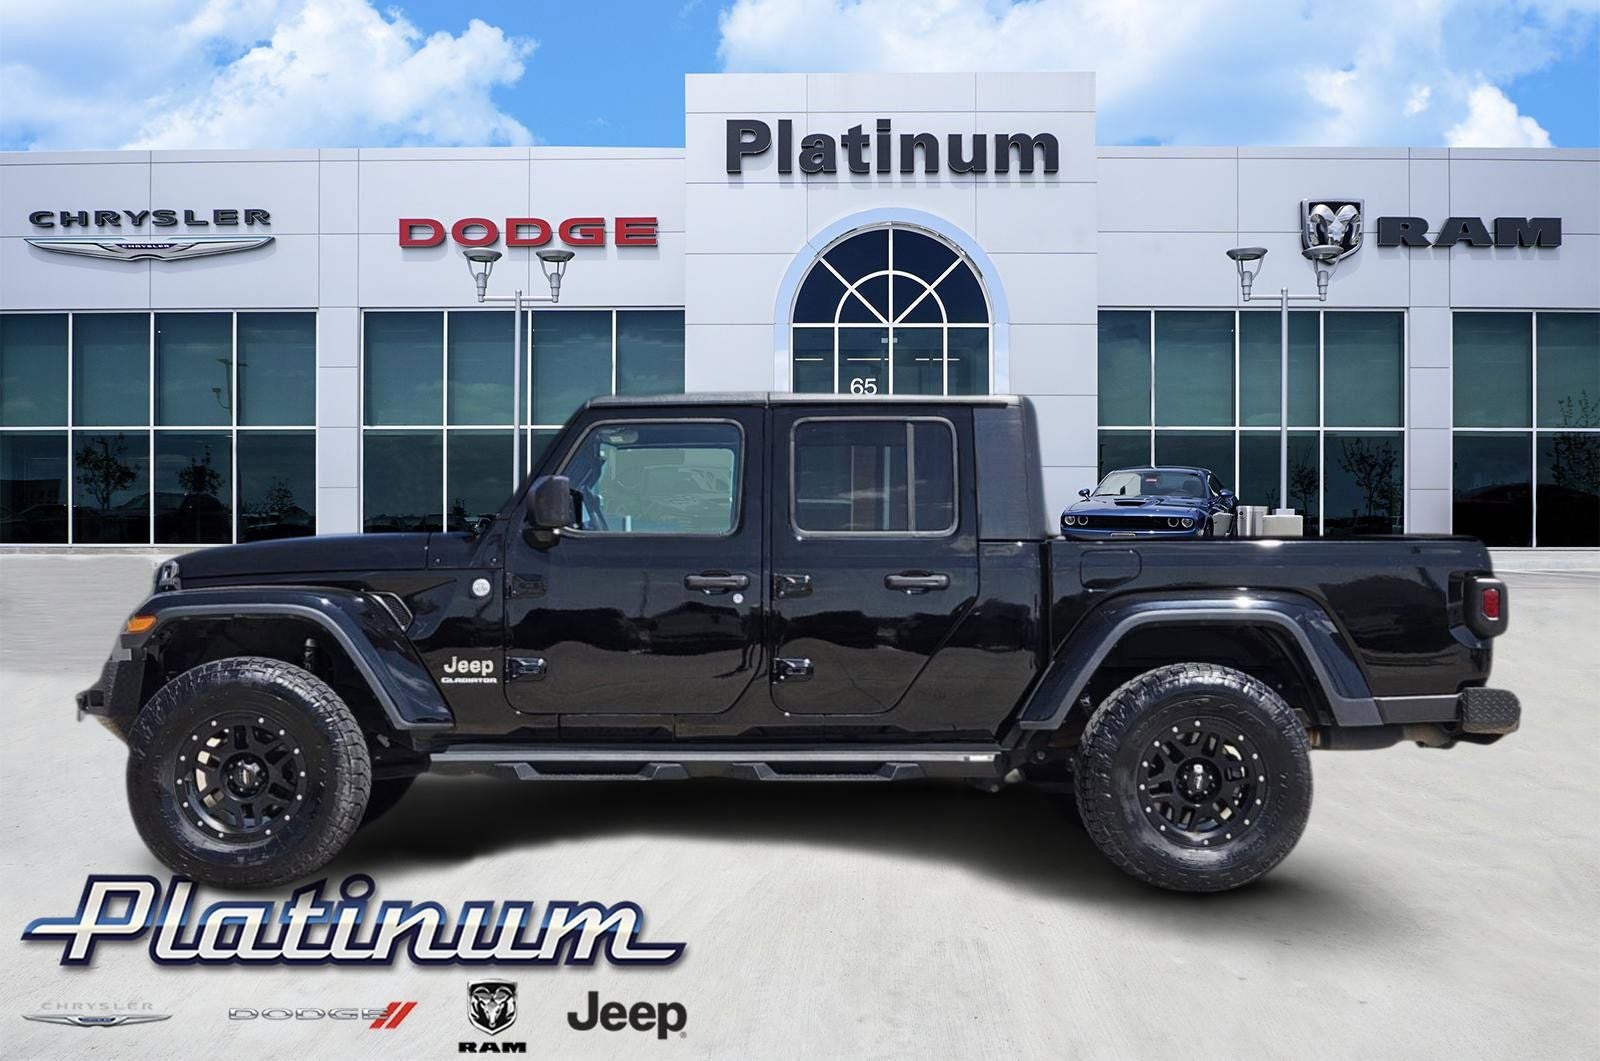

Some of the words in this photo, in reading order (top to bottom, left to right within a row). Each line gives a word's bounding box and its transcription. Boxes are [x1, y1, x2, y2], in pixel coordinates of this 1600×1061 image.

[726, 118, 1060, 176] Platinum
[28, 208, 272, 228] CHRYSLER
[398, 216, 659, 248] DODGE
[1376, 216, 1562, 248] RAM
[850, 377, 878, 395] 65
[443, 656, 494, 676] Jeep
